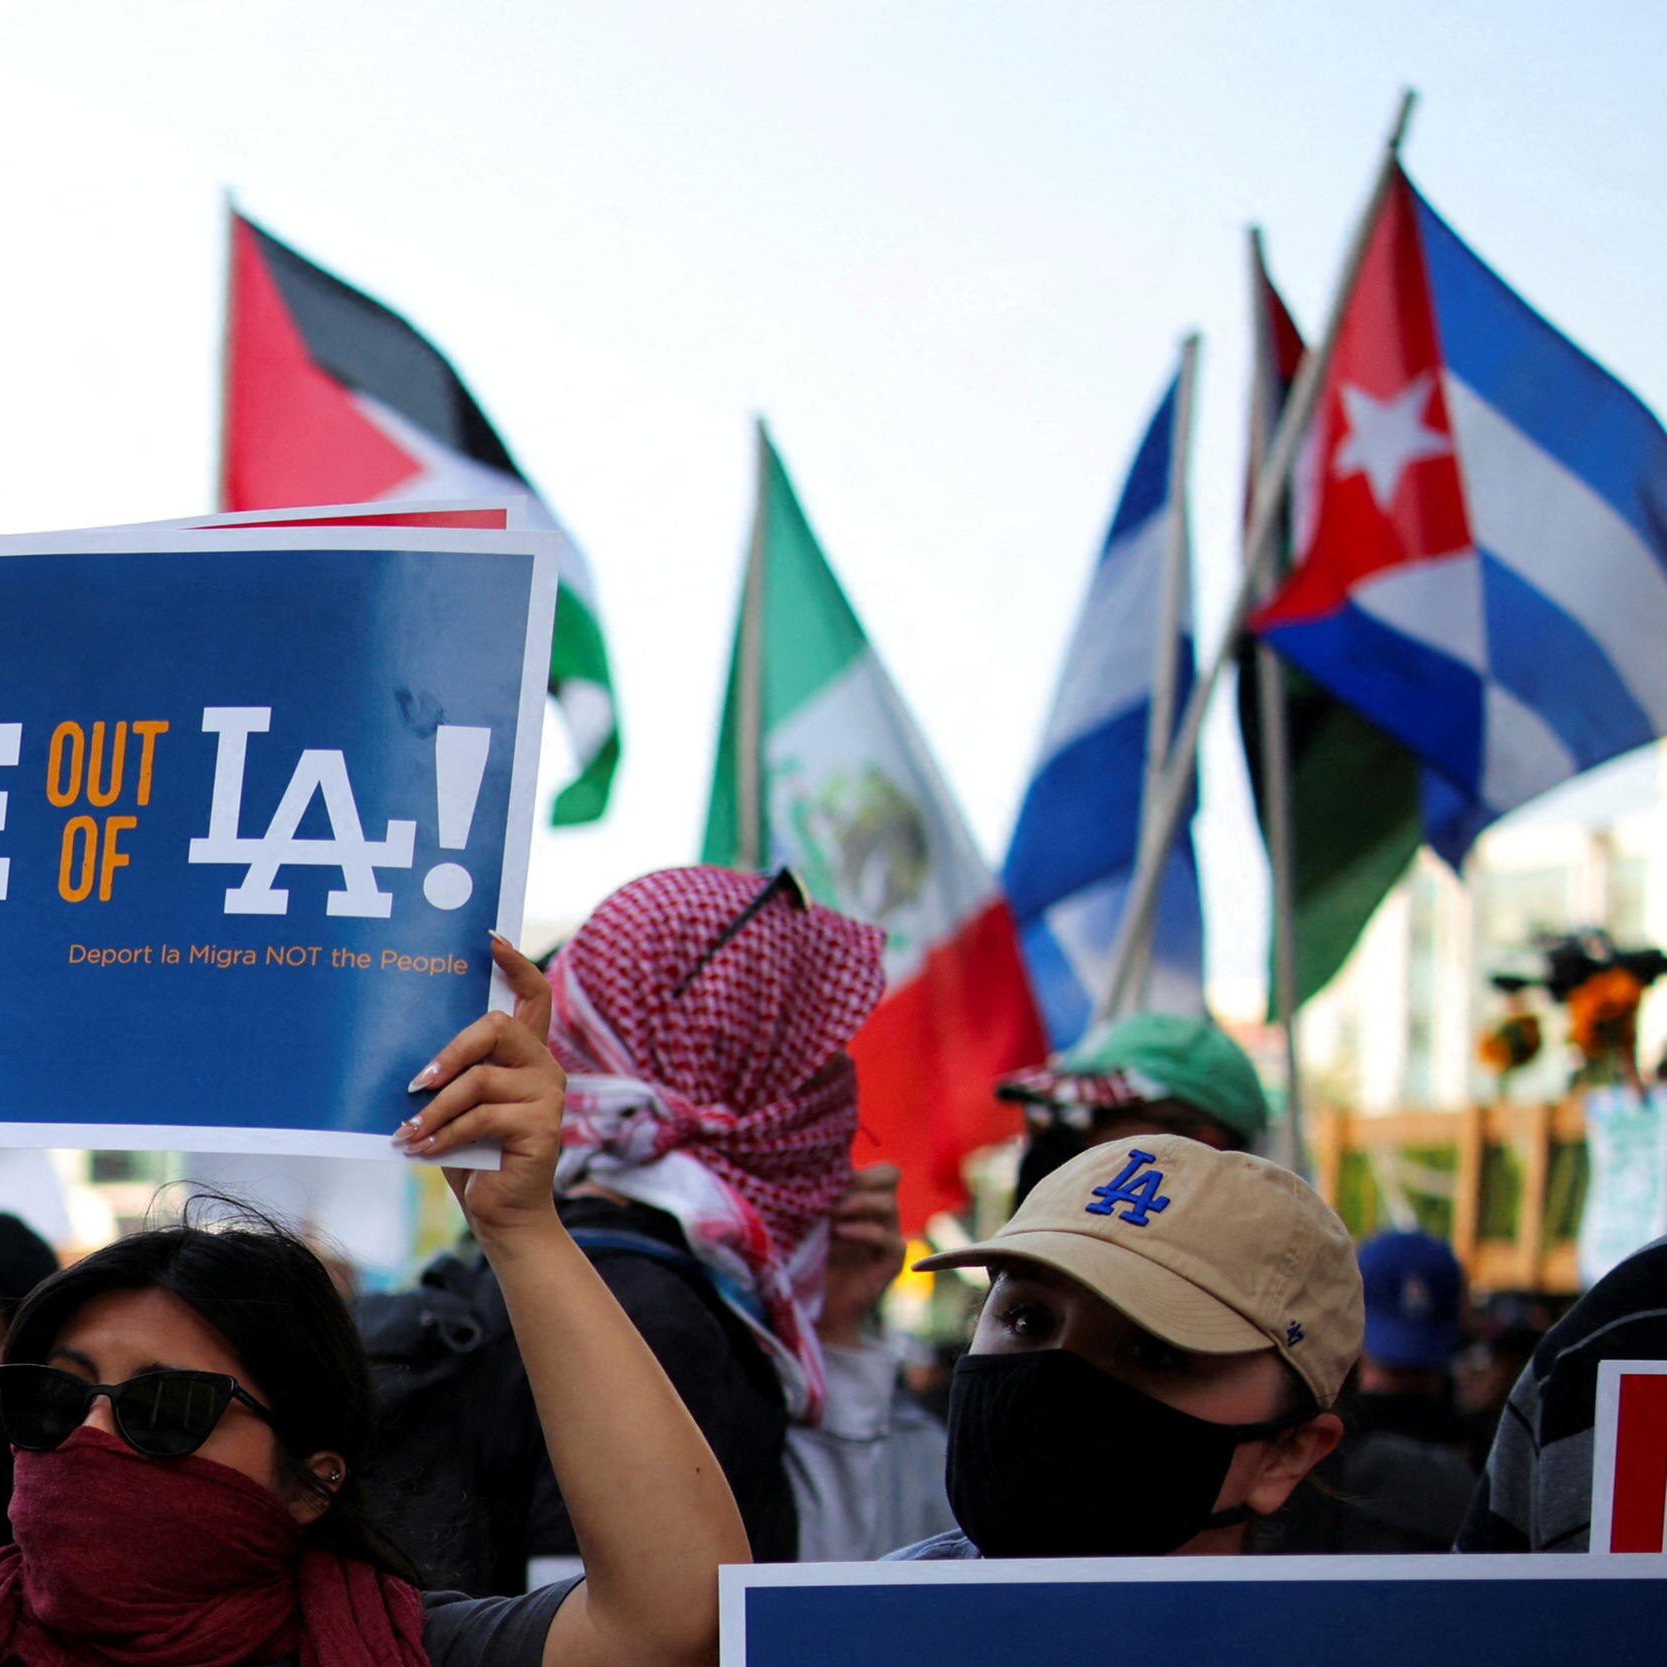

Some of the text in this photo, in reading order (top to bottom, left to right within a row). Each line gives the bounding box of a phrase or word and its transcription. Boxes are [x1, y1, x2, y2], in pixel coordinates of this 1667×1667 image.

[45, 719, 171, 809] OUT
[57, 814, 140, 904] OF
[69, 943, 469, 976] Deport la Migra NOT the People
[1085, 1149, 1170, 1227] LA
